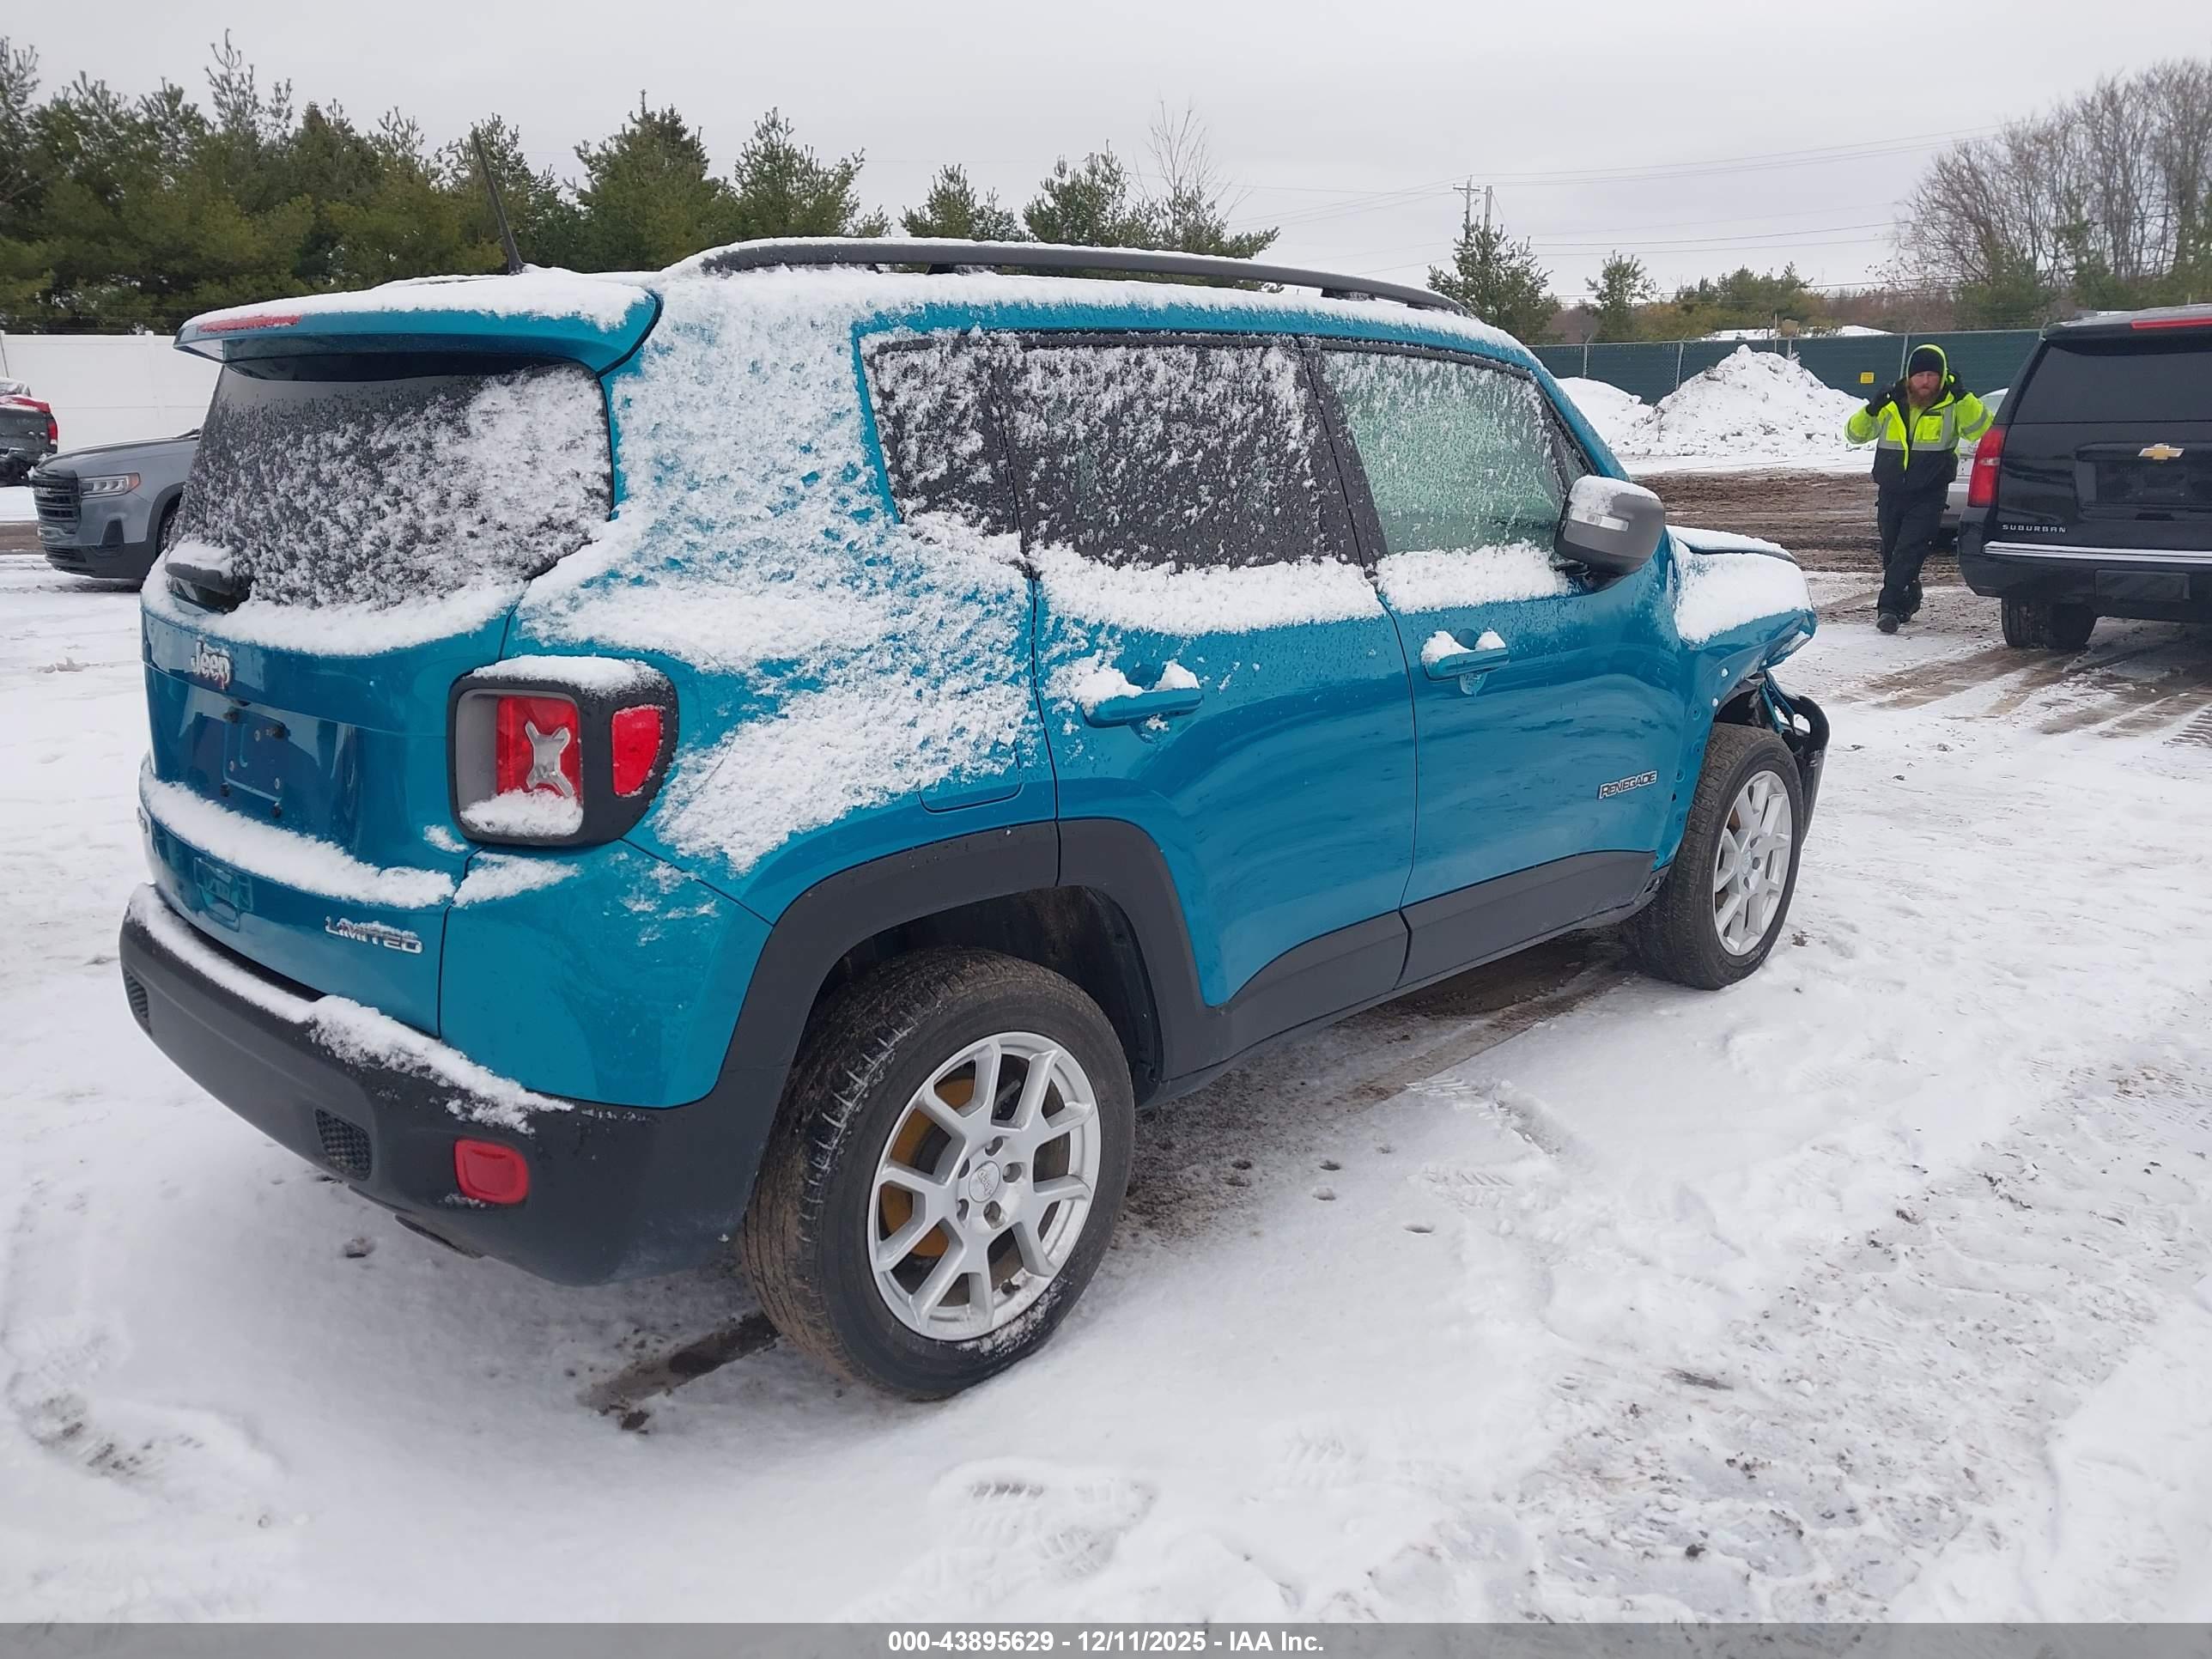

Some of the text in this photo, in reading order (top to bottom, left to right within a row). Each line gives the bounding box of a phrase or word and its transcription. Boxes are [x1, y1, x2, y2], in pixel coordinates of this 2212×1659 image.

[2002, 524, 2066, 533] SUBURBAN
[191, 641, 231, 690] Jeep
[1598, 770, 1658, 799] RENEGADE
[325, 915, 423, 954] LIMITED
[977, 1168, 994, 1196] Jeep
